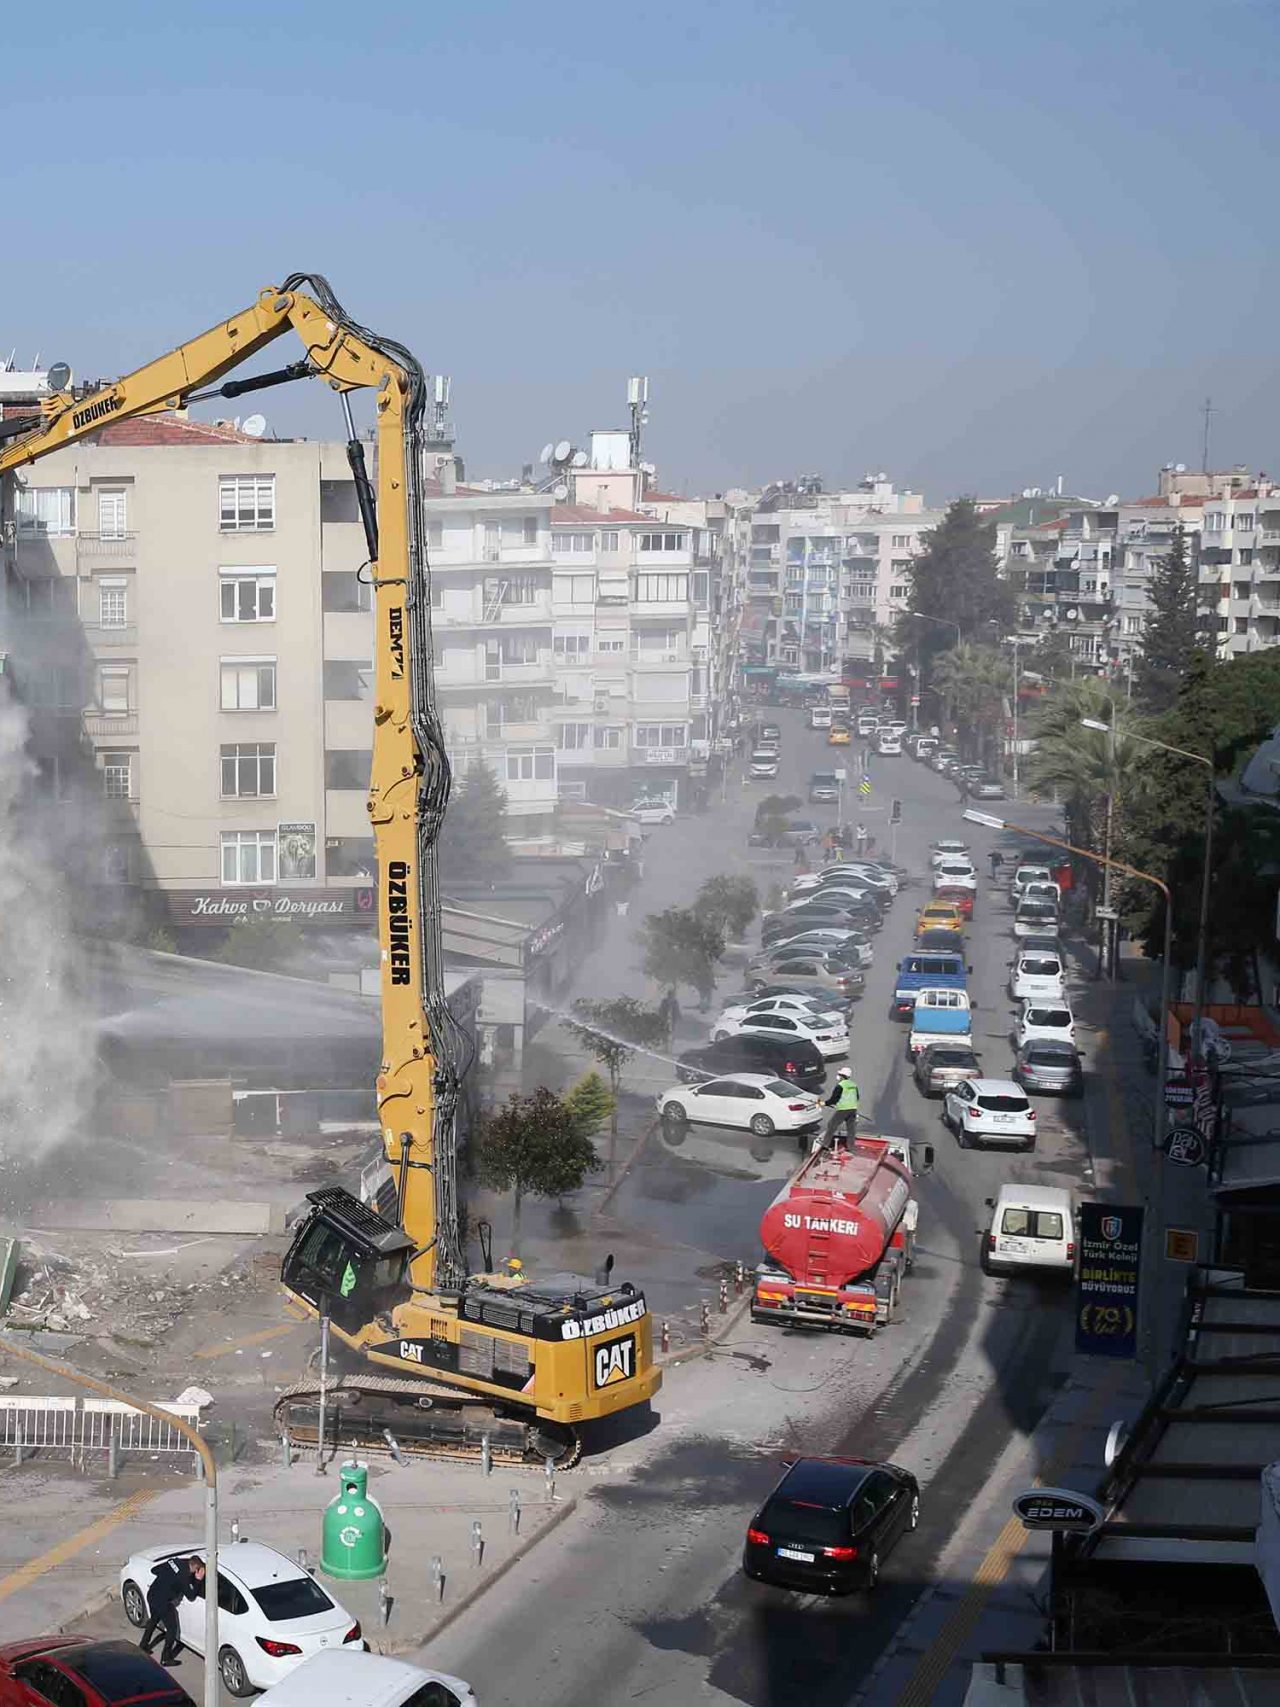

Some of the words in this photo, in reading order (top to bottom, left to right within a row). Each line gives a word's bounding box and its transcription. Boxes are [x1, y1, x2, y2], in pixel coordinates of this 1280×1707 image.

[192, 898, 248, 914] Kahve
[275, 897, 344, 918] Deryası
[389, 861, 412, 985] ÖZBÜKER
[784, 1213, 801, 1228] SU
[804, 1215, 859, 1236] TANKERİ
[561, 1299, 646, 1340] ÖZBÜKER
[400, 1341, 423, 1363] CAT
[596, 1340, 632, 1387] CAT
[1027, 1508, 1083, 1518] EDEM
